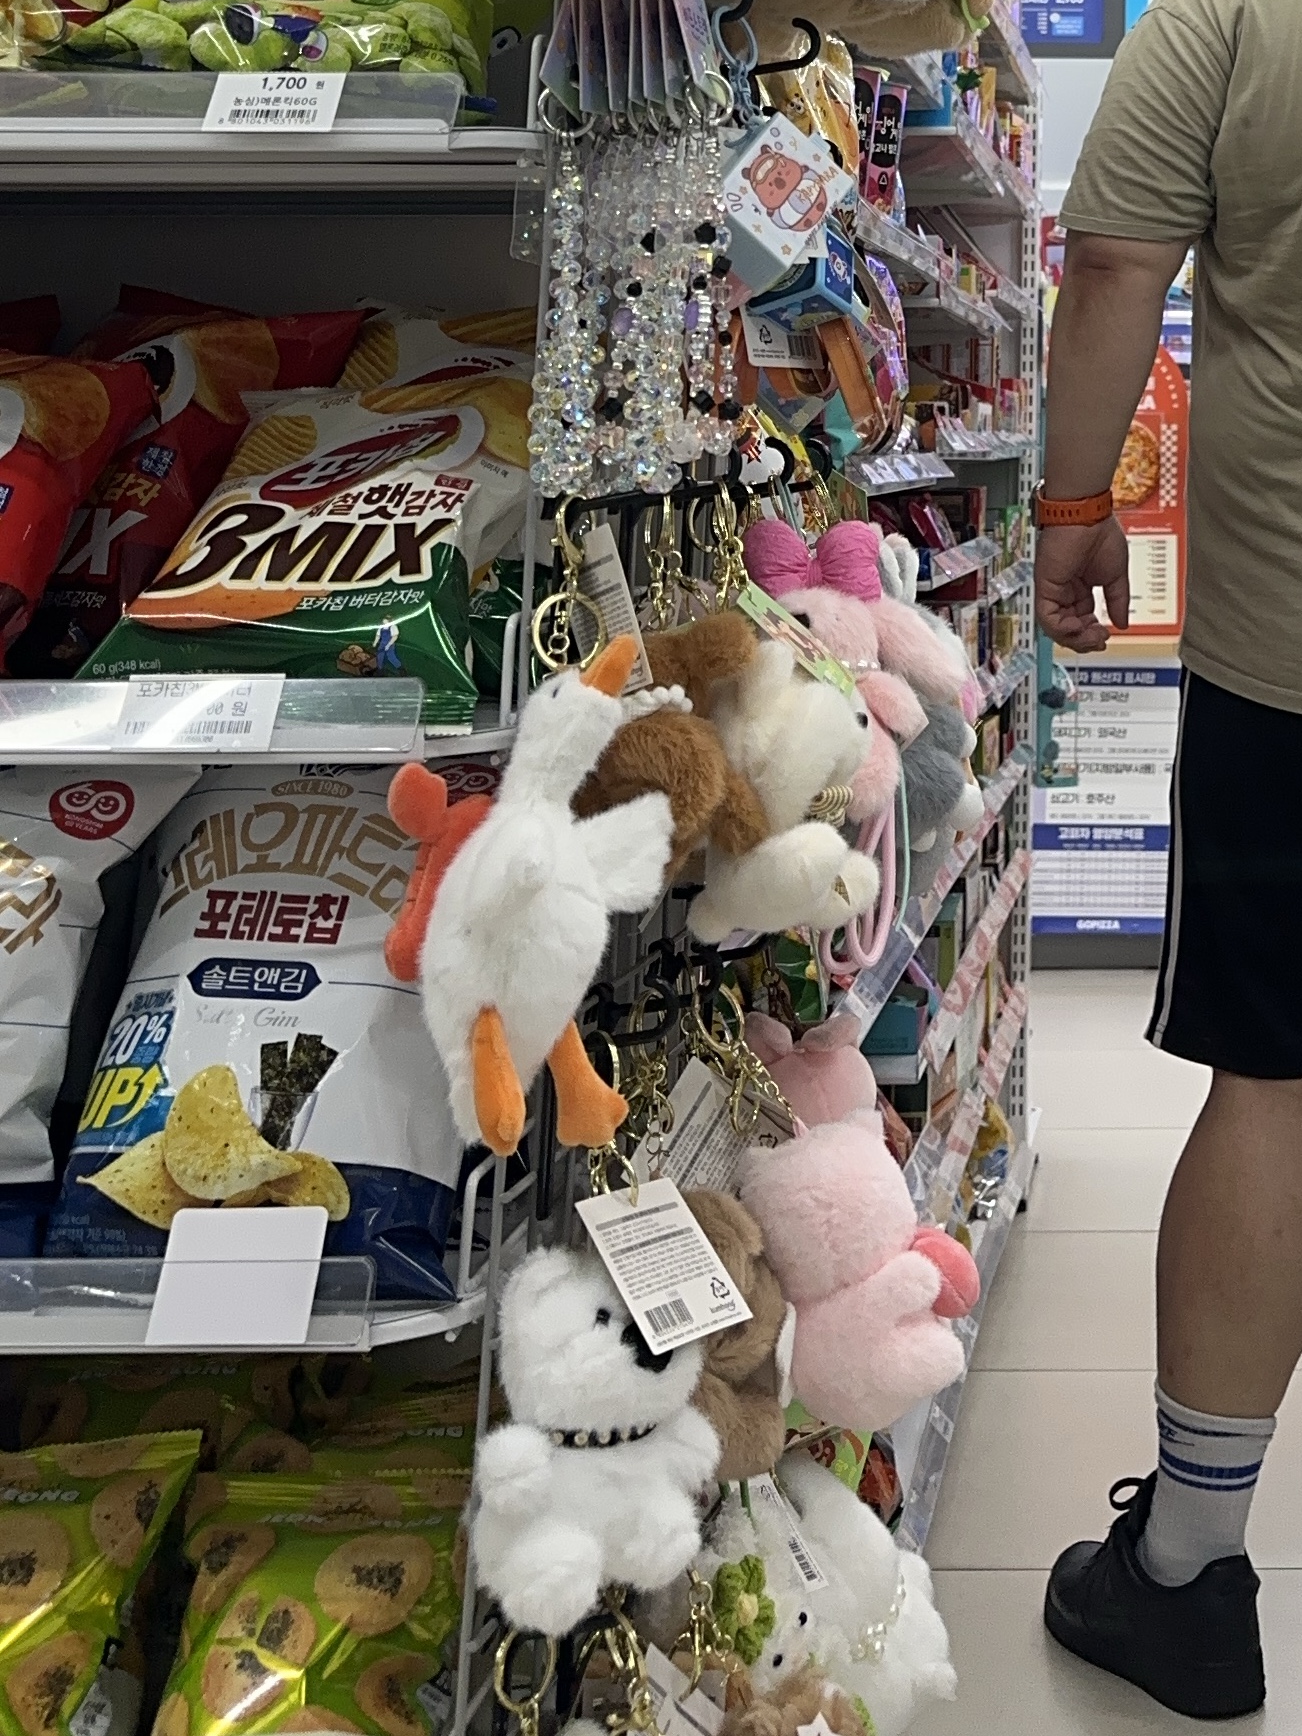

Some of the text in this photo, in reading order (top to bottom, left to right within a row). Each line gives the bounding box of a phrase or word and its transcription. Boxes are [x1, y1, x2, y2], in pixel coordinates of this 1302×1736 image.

[262, 76, 307, 91] 1,700
[296, 589, 425, 612] 포카칩 버터감자맛
[201, 965, 308, 995] 솔트앤김
